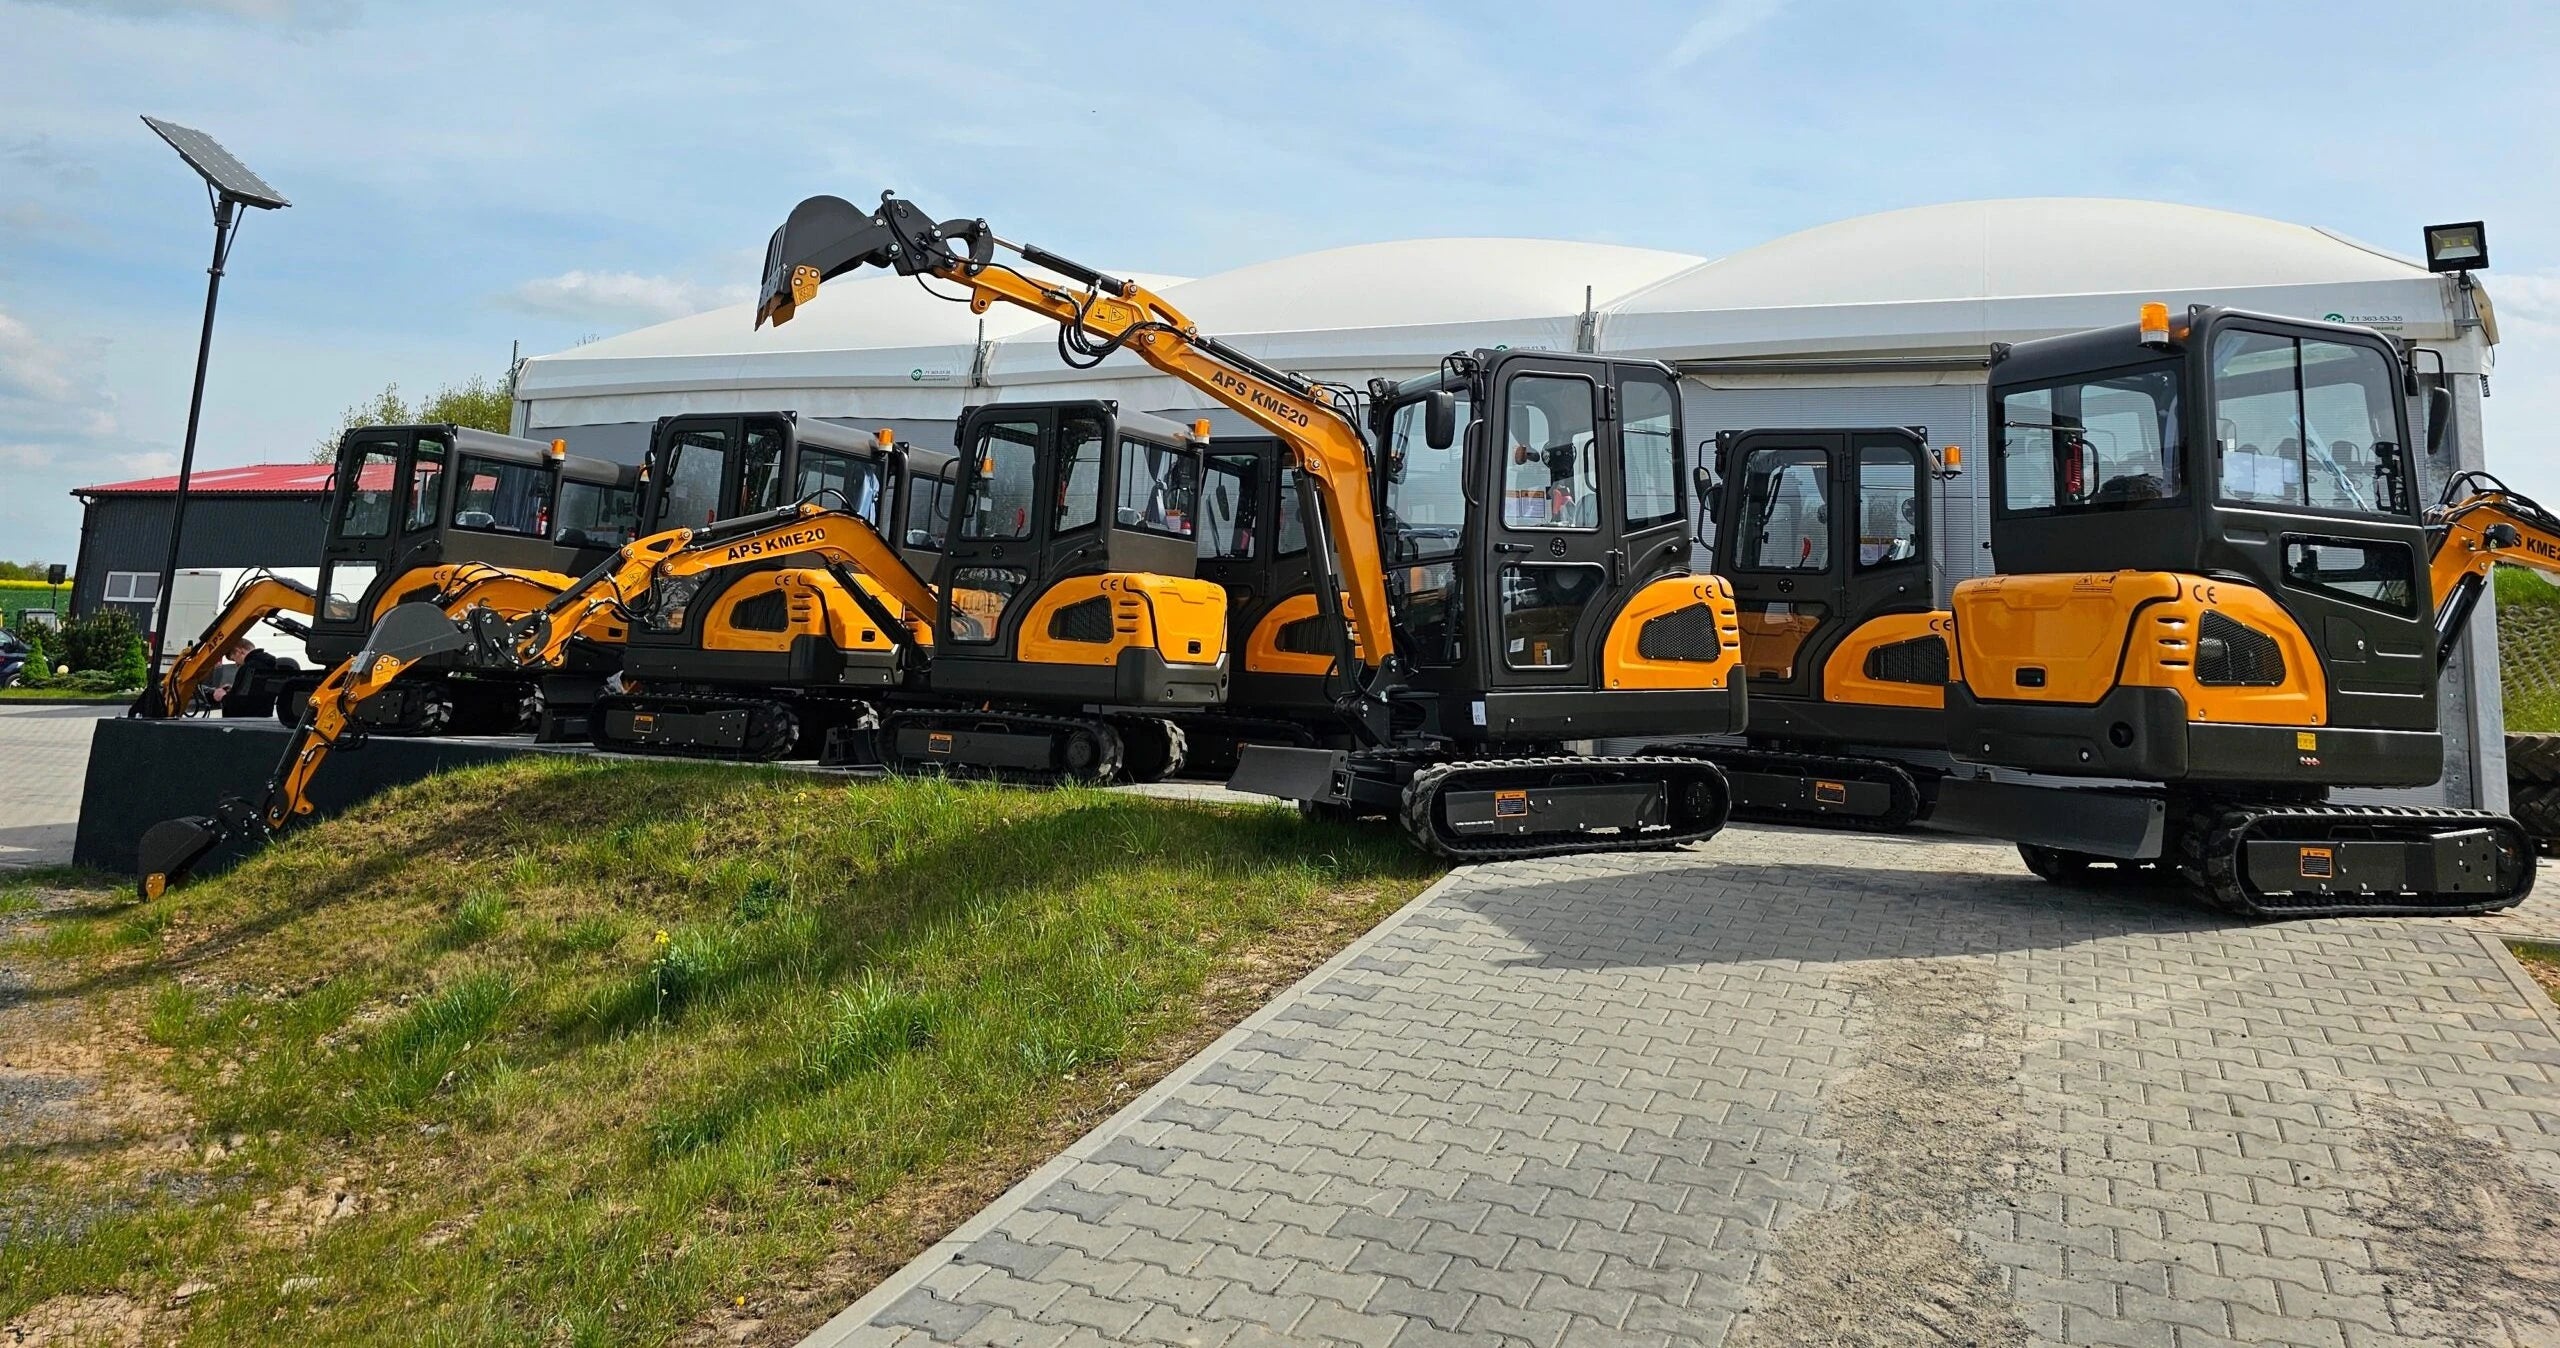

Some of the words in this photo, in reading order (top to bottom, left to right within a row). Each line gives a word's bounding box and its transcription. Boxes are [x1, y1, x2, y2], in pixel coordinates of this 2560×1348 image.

[1211, 371, 1248, 396] APS
[1250, 389, 1309, 428] KME20
[728, 541, 762, 561] APS
[765, 528, 826, 551] KME20
[2526, 536, 2560, 561] KME
[433, 570, 448, 581] CE
[774, 574, 792, 586] CE
[1100, 578, 1119, 591] CE
[1693, 584, 1715, 600] CE
[2192, 584, 2217, 605] CE
[1929, 618, 1953, 632] CE
